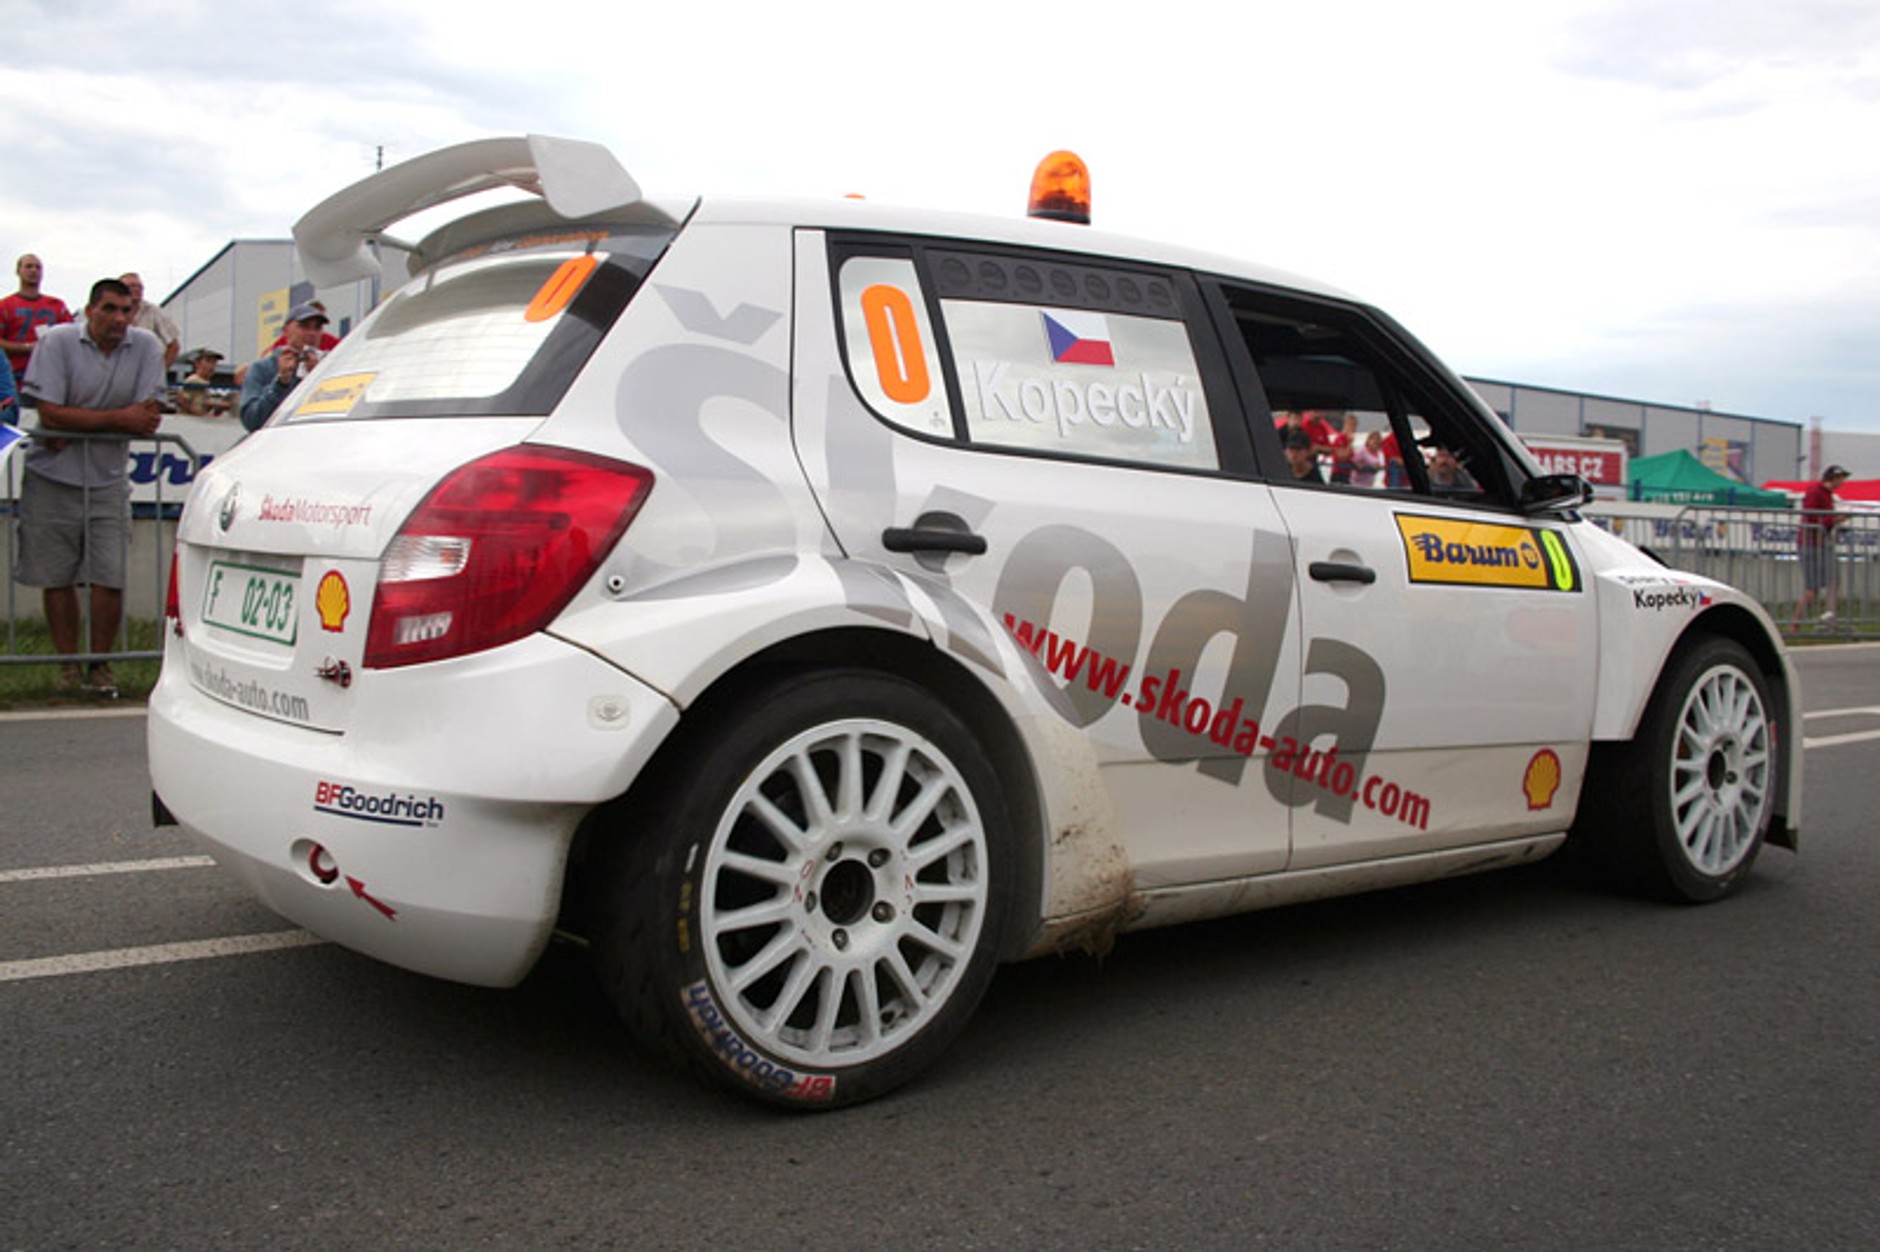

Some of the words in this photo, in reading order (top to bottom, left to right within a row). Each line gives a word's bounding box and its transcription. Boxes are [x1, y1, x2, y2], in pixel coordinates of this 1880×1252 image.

[861, 284, 931, 404] 0
[973, 359, 1196, 442] Kopecký
[1411, 532, 1519, 568] Barum
[208, 570, 223, 617] F
[1003, 612, 1430, 831] www.skoda-auto.com
[314, 780, 444, 821] BFGoodrich
